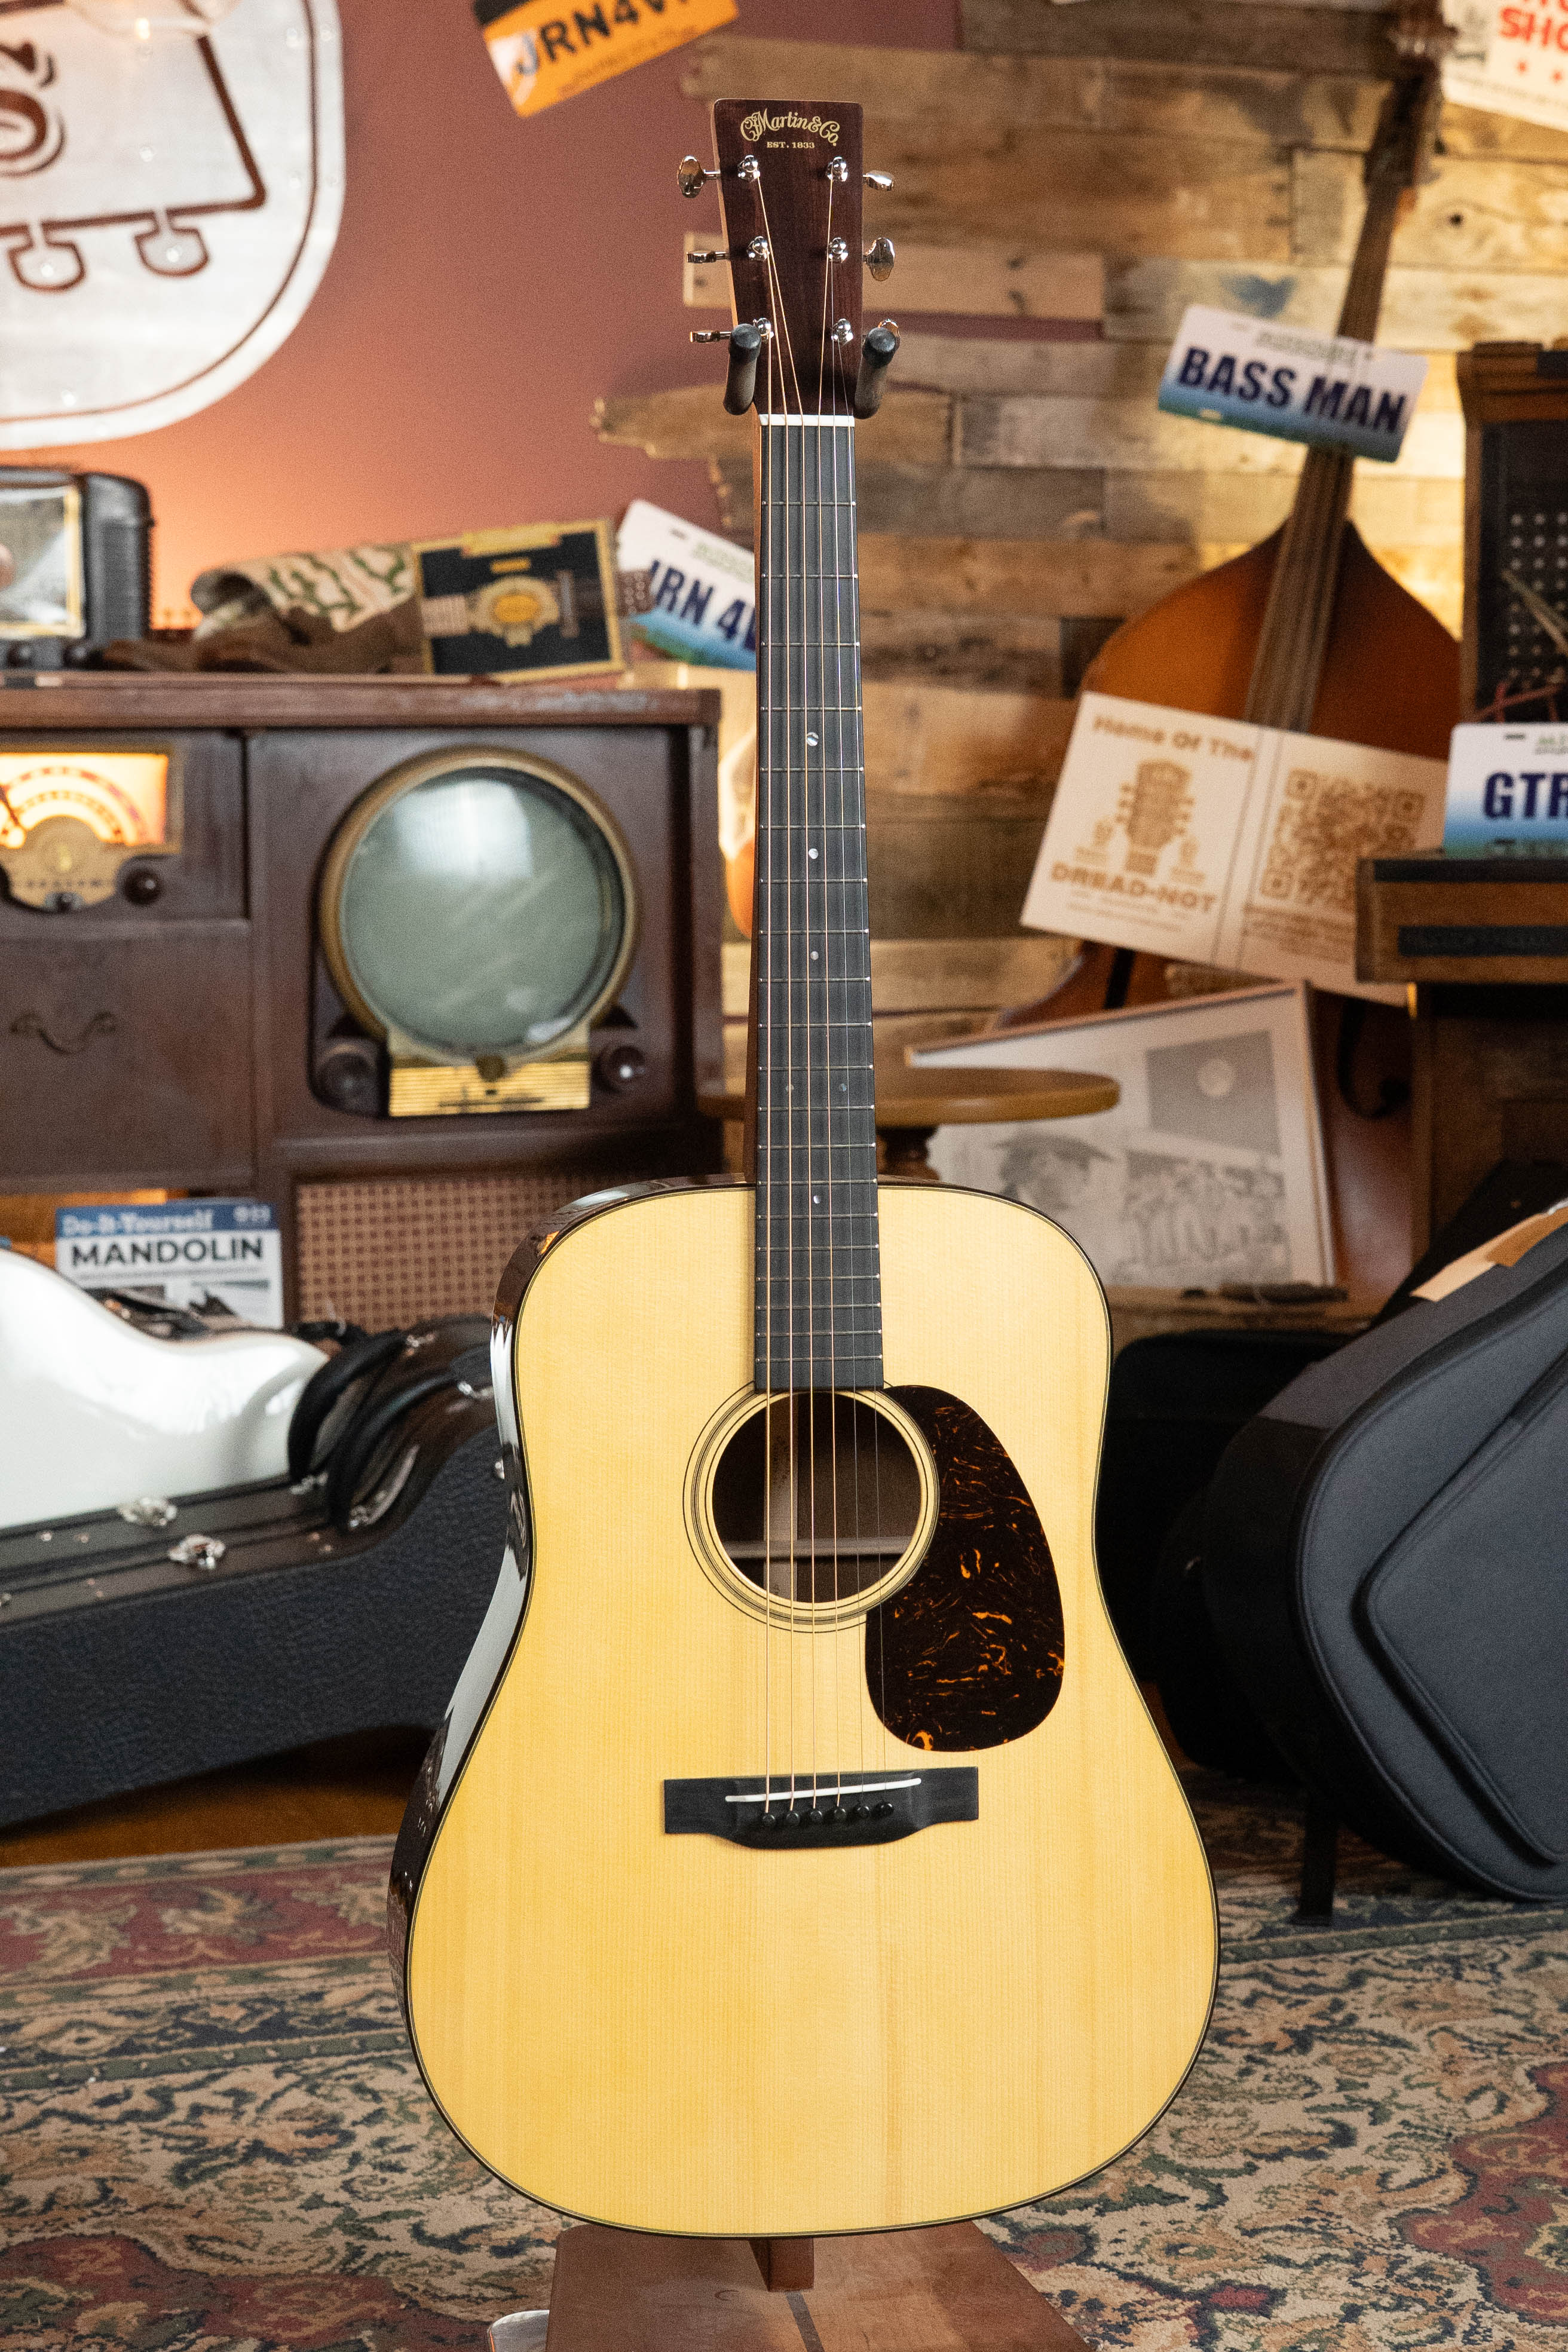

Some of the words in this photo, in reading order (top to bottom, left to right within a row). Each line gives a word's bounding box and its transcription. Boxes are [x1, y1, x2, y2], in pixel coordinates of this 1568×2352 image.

[516, 0, 688, 76] JRN4
[1178, 345, 1297, 409] BASS
[1303, 375, 1407, 433] MAN
[72, 1237, 263, 1267] MANDOLIN
